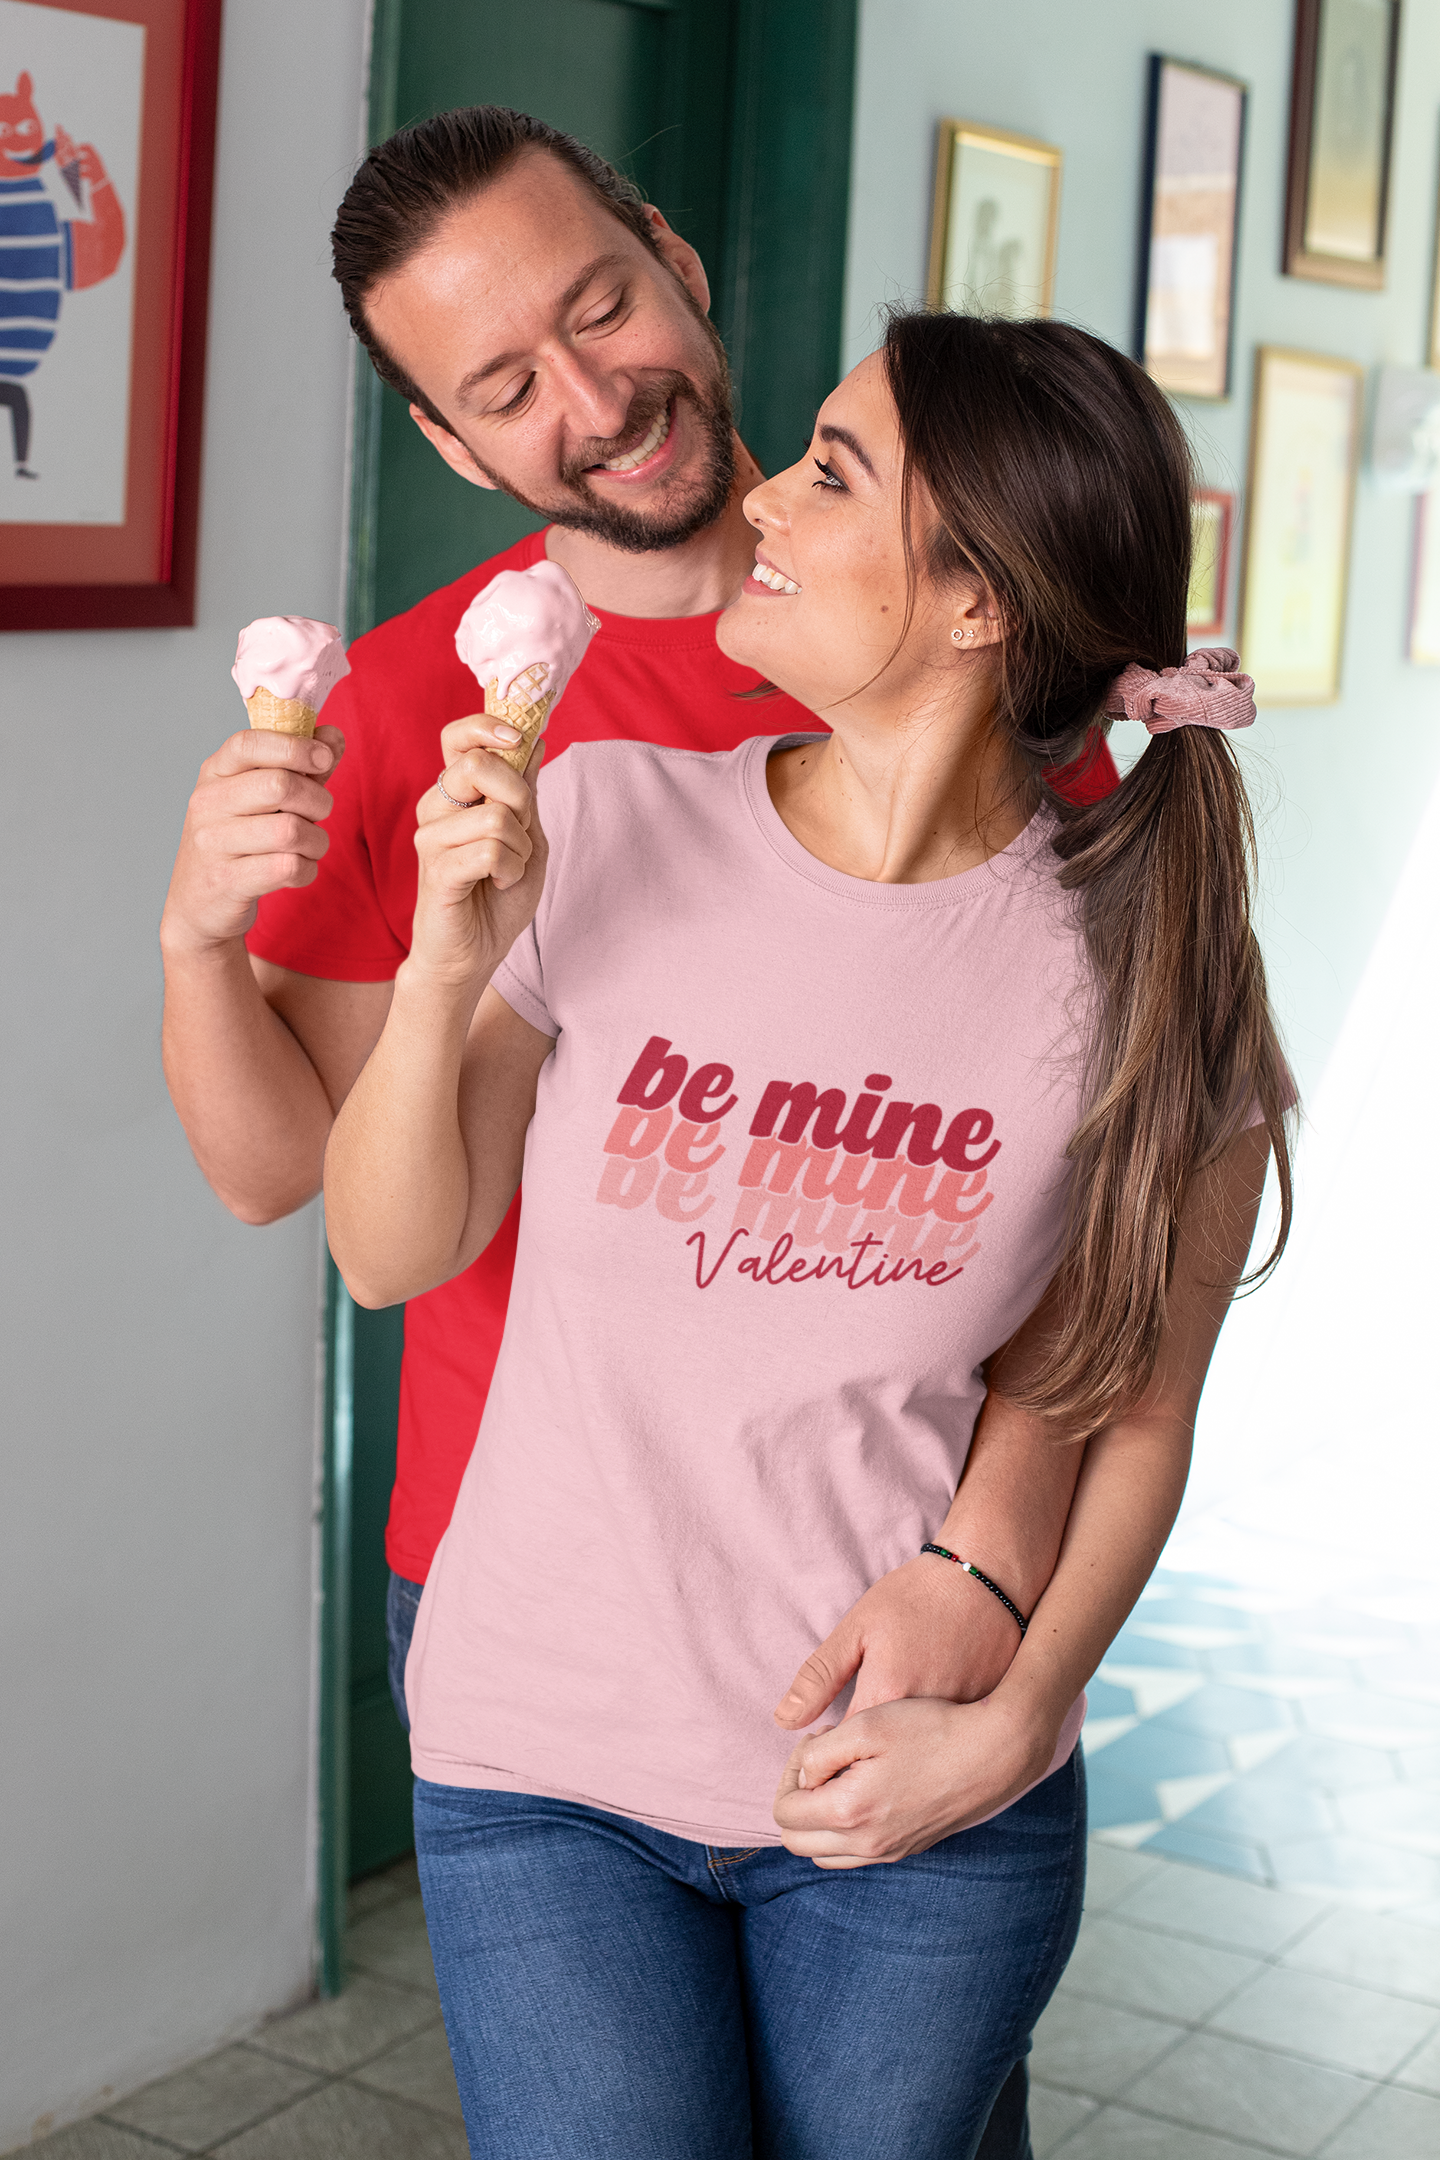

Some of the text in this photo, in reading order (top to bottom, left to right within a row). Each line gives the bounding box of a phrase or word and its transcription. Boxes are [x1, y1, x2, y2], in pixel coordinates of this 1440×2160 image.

[616, 1036, 1002, 1172] be mine
[603, 1105, 726, 1173] be
[686, 1228, 963, 1289] Valentine
